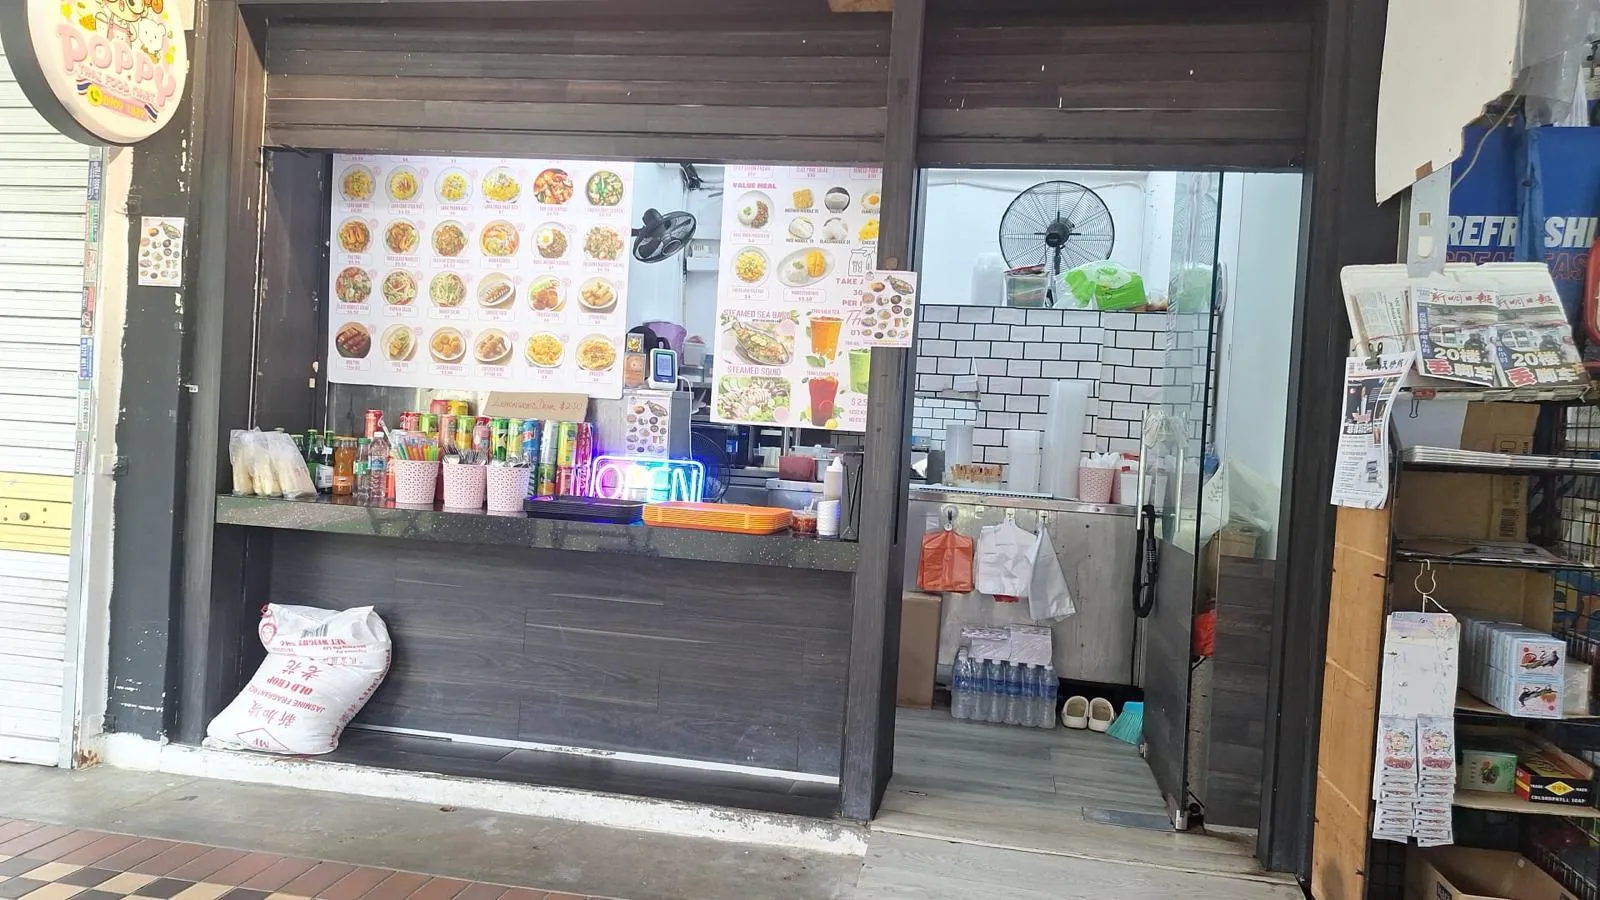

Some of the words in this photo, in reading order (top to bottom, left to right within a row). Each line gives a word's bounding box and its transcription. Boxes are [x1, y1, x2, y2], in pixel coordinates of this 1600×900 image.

[57, 23, 176, 107] POPPY
[732, 181, 756, 189] VALUE
[1447, 215, 1598, 248] REFRSHI
[723, 309, 755, 319] STEAMED
[727, 365, 759, 375] STEAMED
[760, 367, 782, 376] SQUID
[595, 464, 702, 503] OPEN
[266, 676, 291, 690] CROP
[291, 683, 313, 696] OLD
[257, 688, 292, 706] FRAGRANT
[292, 699, 326, 713] JASMINE
